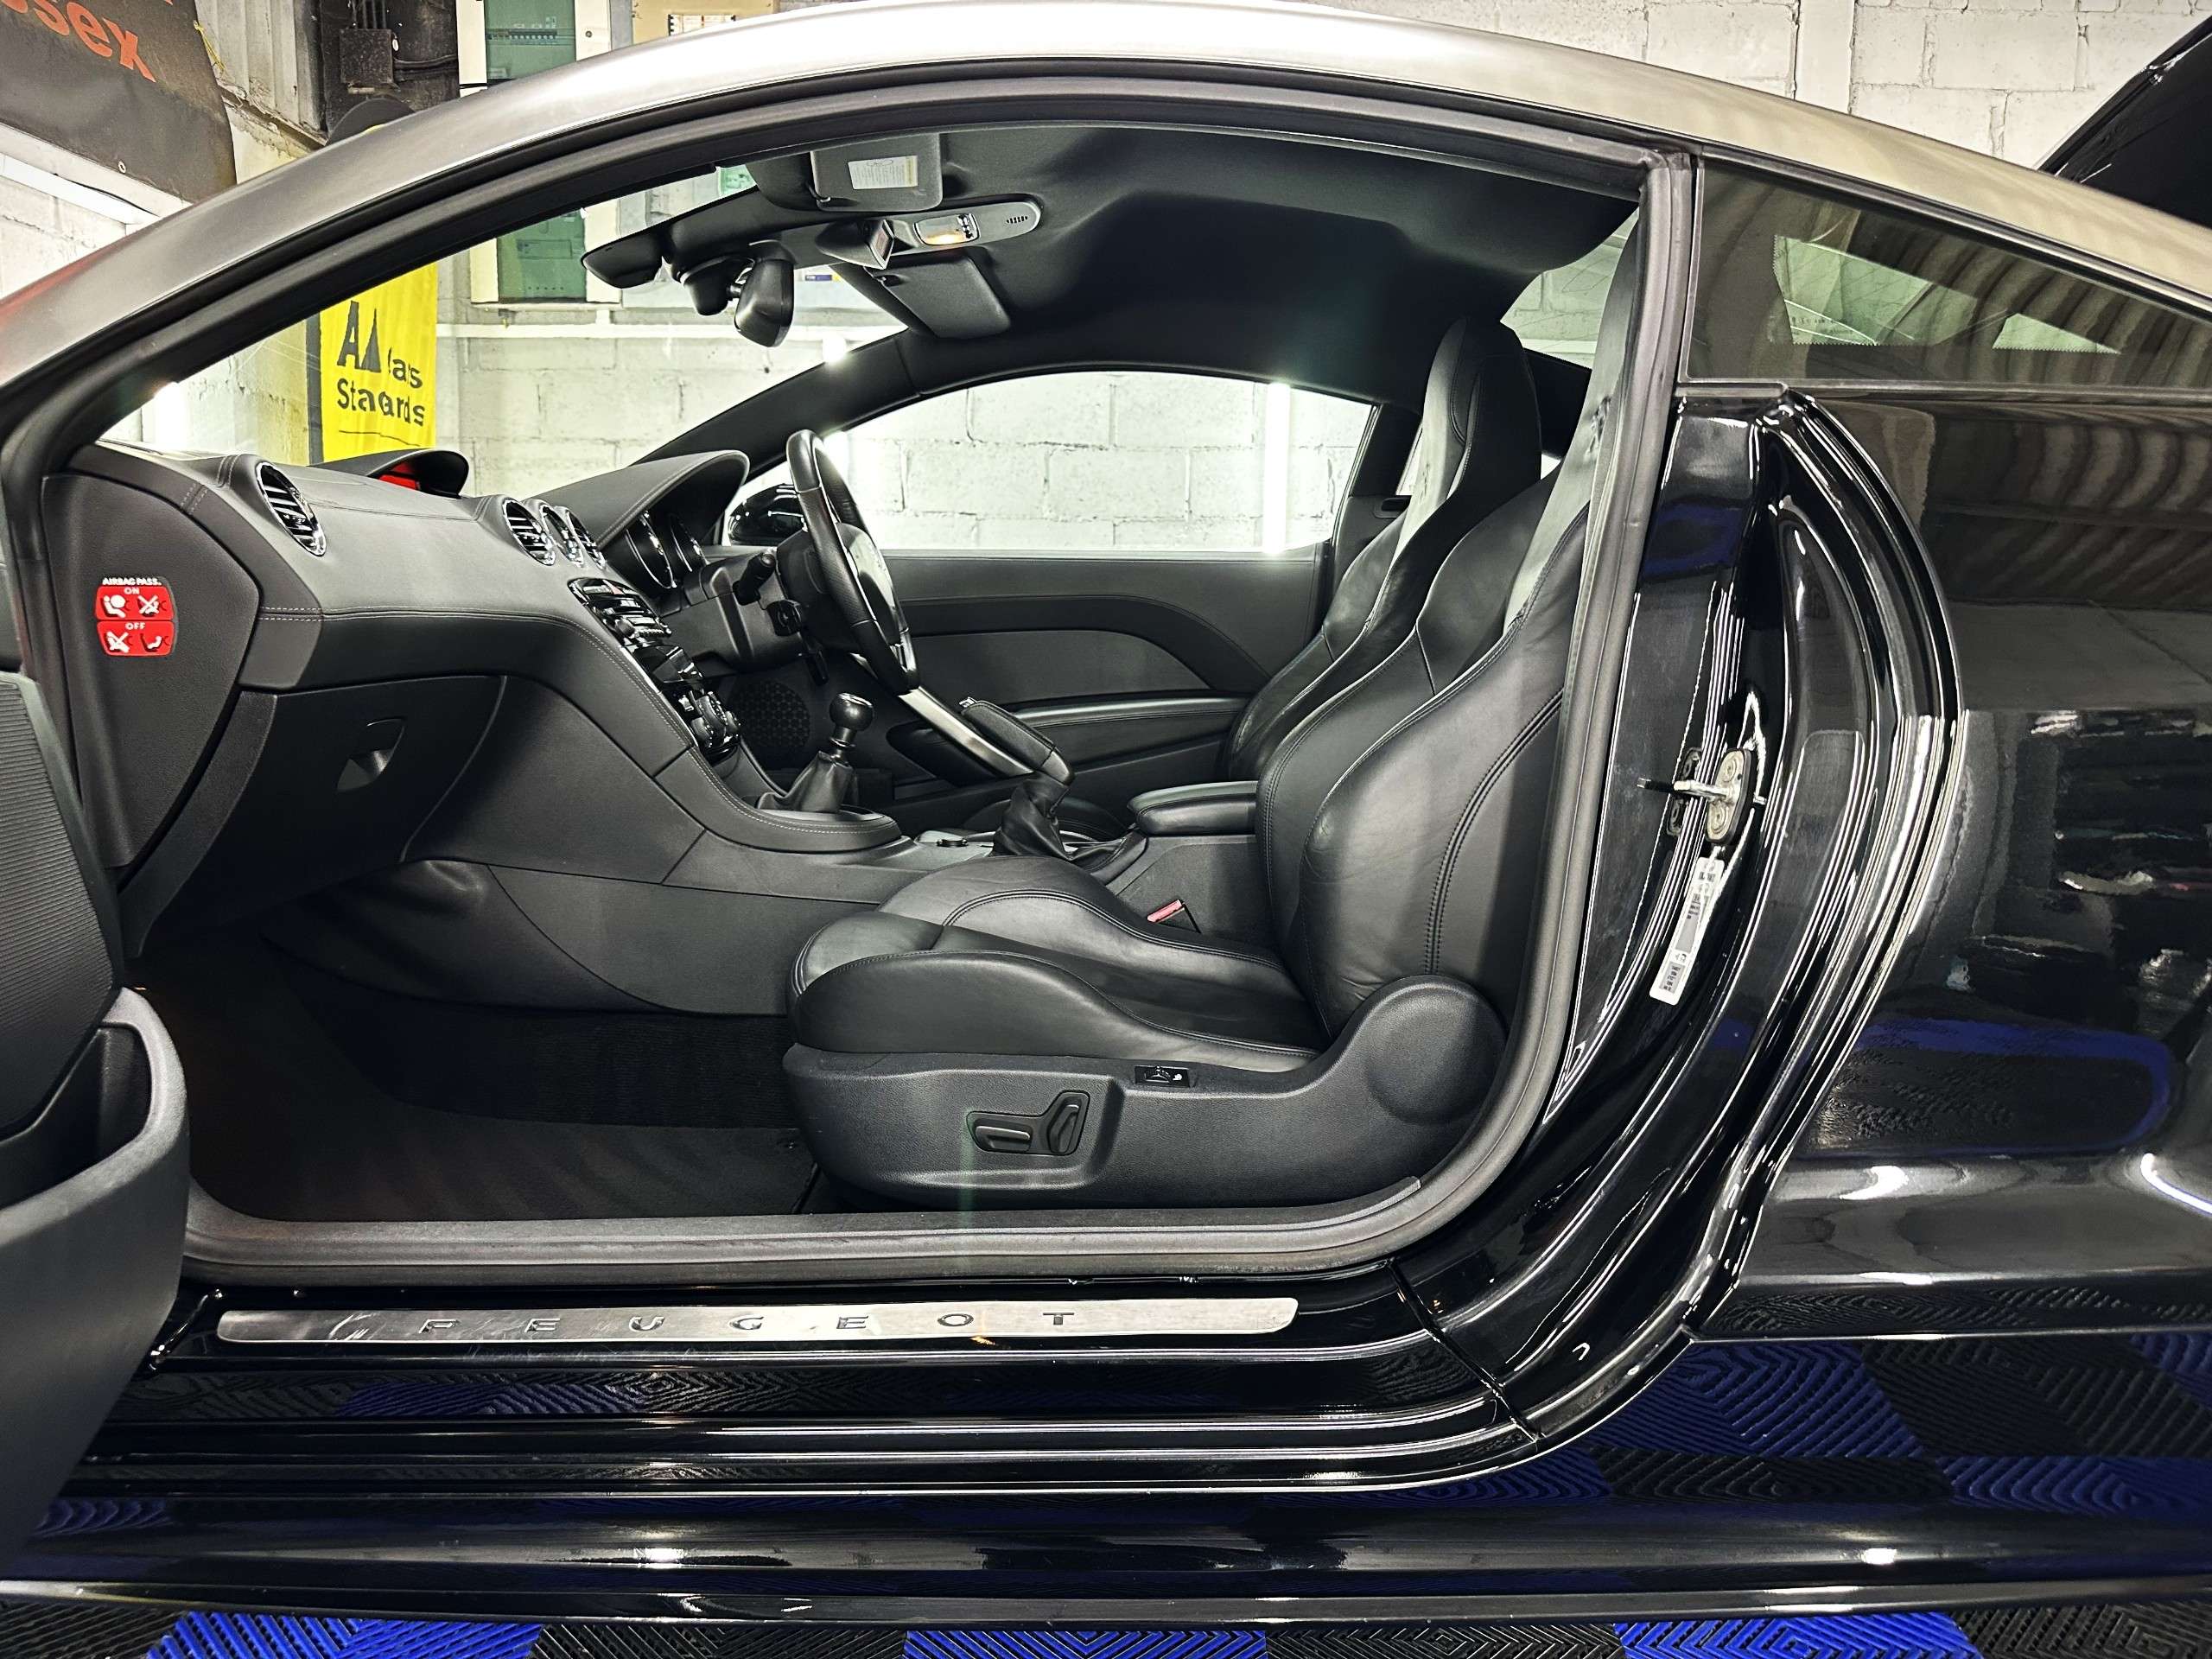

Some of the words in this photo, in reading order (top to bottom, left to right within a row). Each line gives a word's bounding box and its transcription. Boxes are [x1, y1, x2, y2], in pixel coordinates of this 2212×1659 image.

[1, 0, 157, 83] sex
[102, 577, 136, 586] AIRBAG
[124, 587, 140, 595] ON
[125, 622, 145, 631] OFF
[418, 1312, 1075, 1334] PEUGEOT
